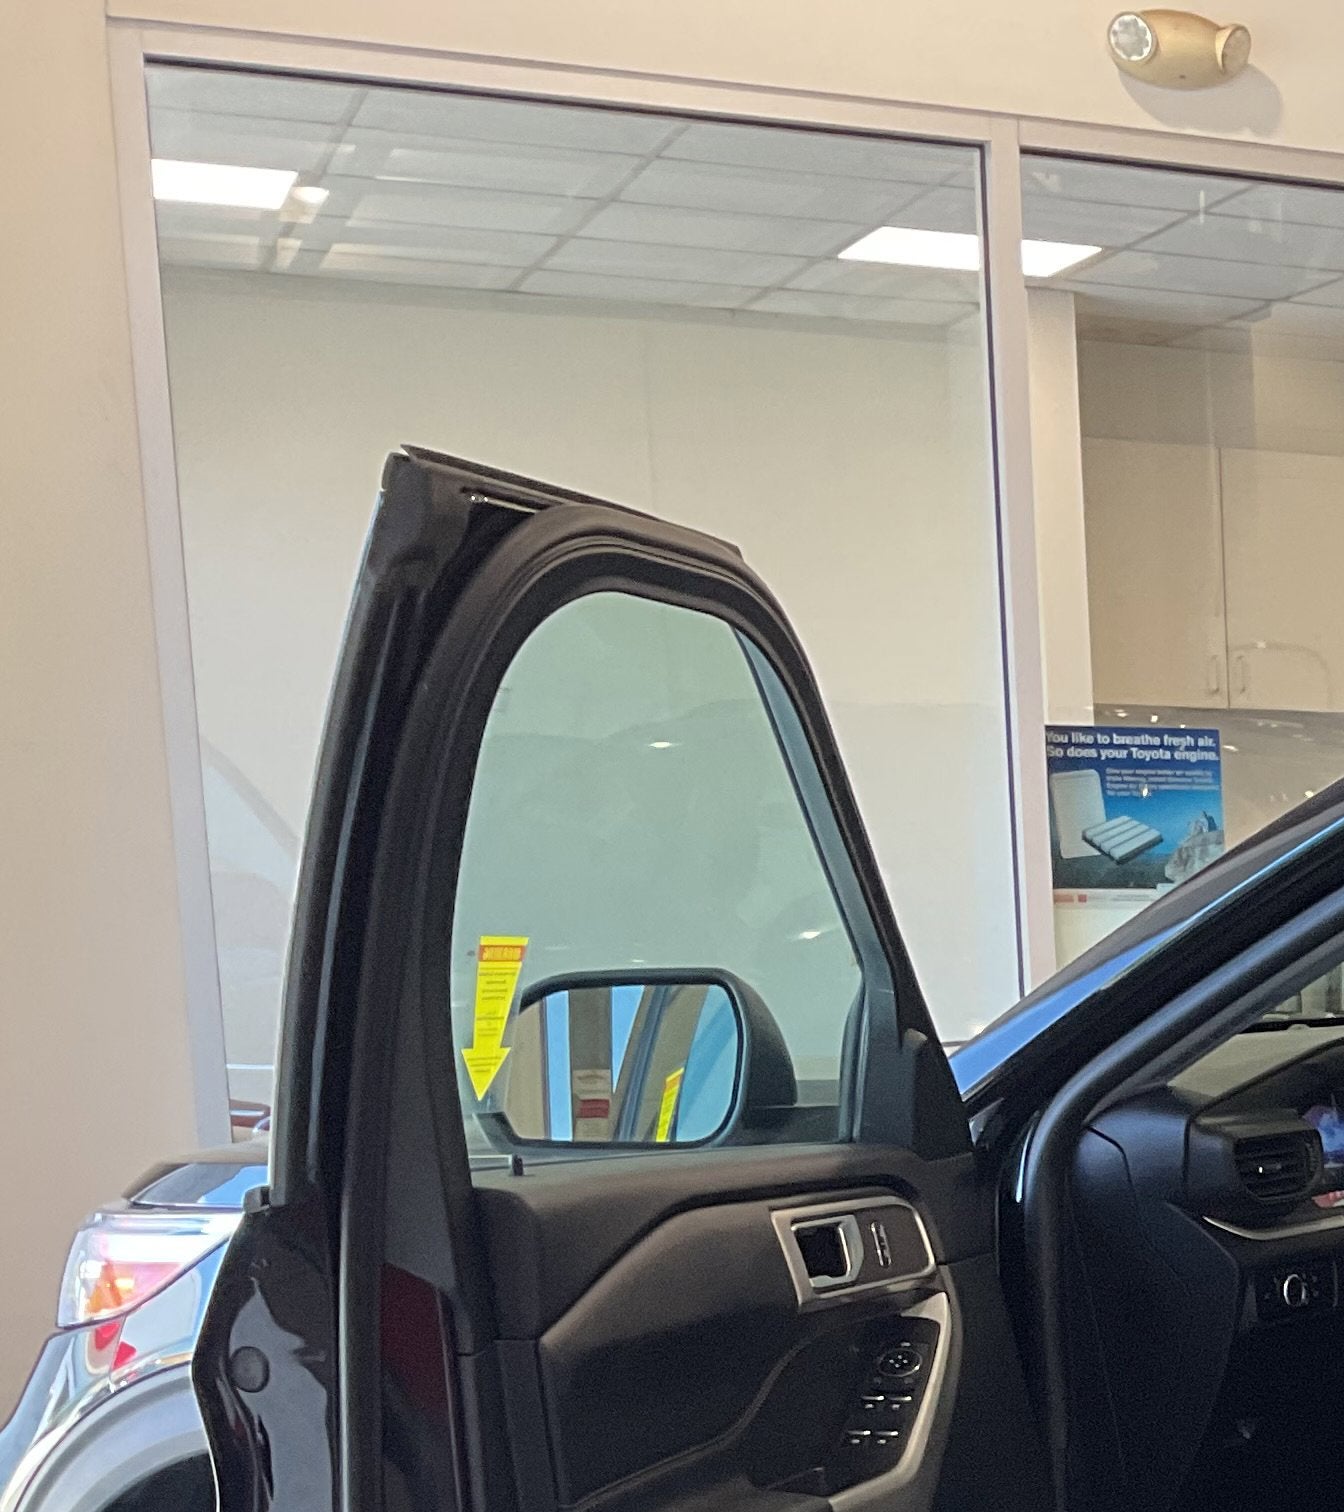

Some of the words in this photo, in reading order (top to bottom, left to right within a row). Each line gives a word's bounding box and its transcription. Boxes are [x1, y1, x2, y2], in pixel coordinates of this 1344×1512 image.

[1071, 731, 1094, 745] like
[1097, 733, 1110, 745] to
[1113, 733, 1161, 746] breathe
[1163, 734, 1195, 748] fresh
[1197, 736, 1217, 748] air.
[1046, 745, 1064, 758] So
[1066, 745, 1098, 758] does
[1100, 748, 1129, 761] your
[1130, 747, 1171, 762] Toyota
[1174, 748, 1219, 763] engine.
